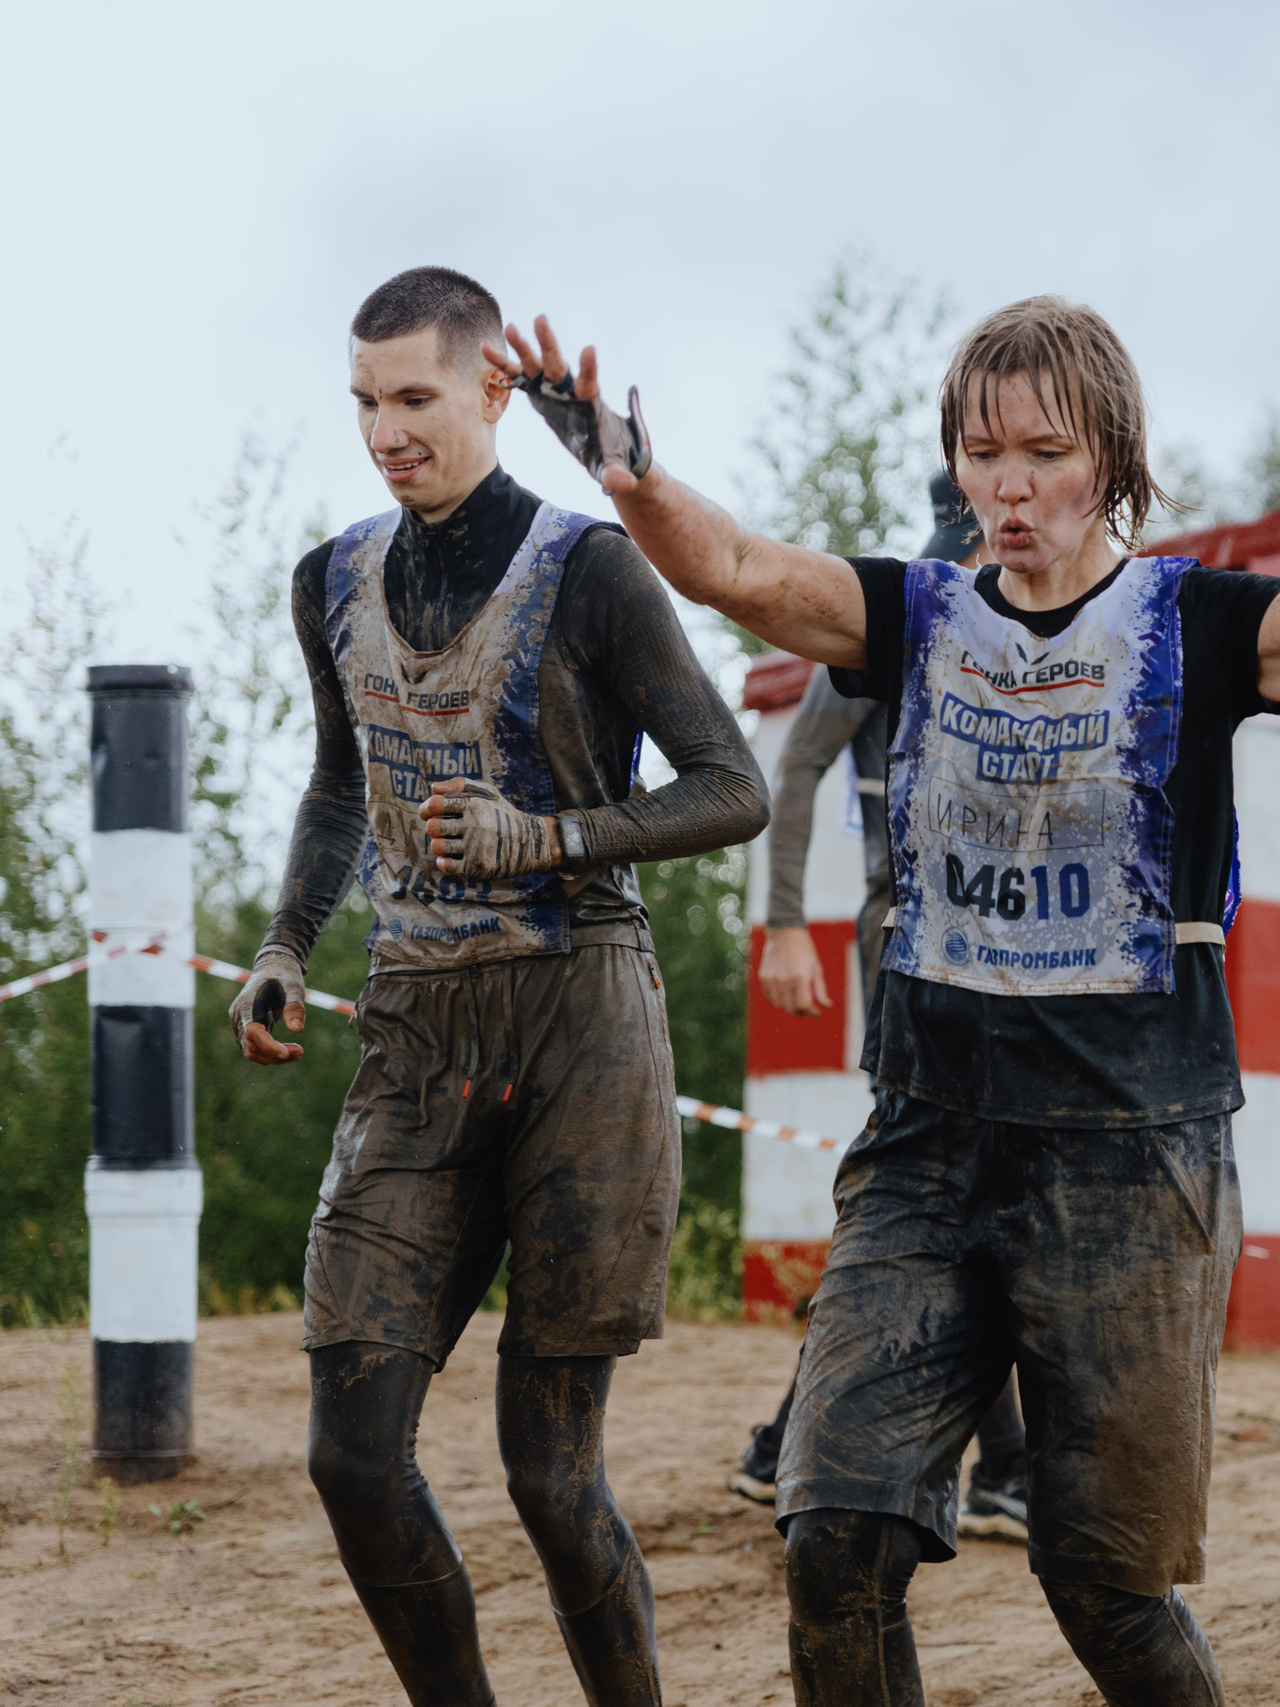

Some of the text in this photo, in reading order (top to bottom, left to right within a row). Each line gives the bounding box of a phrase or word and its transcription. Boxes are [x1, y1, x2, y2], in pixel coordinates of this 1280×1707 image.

[1022, 660, 1105, 684] ГЕРОЕВ
[364, 673, 470, 709] ГОН ГЕРОЕВ
[942, 699, 1105, 752] КОМАНДНЫЙ
[982, 751, 1054, 782] СТАРТ
[392, 769, 428, 800] СТА
[937, 793, 1053, 848] ИРИНА
[946, 853, 1090, 920] 04610
[977, 945, 1097, 969] ГАЗПРОМБАНК
